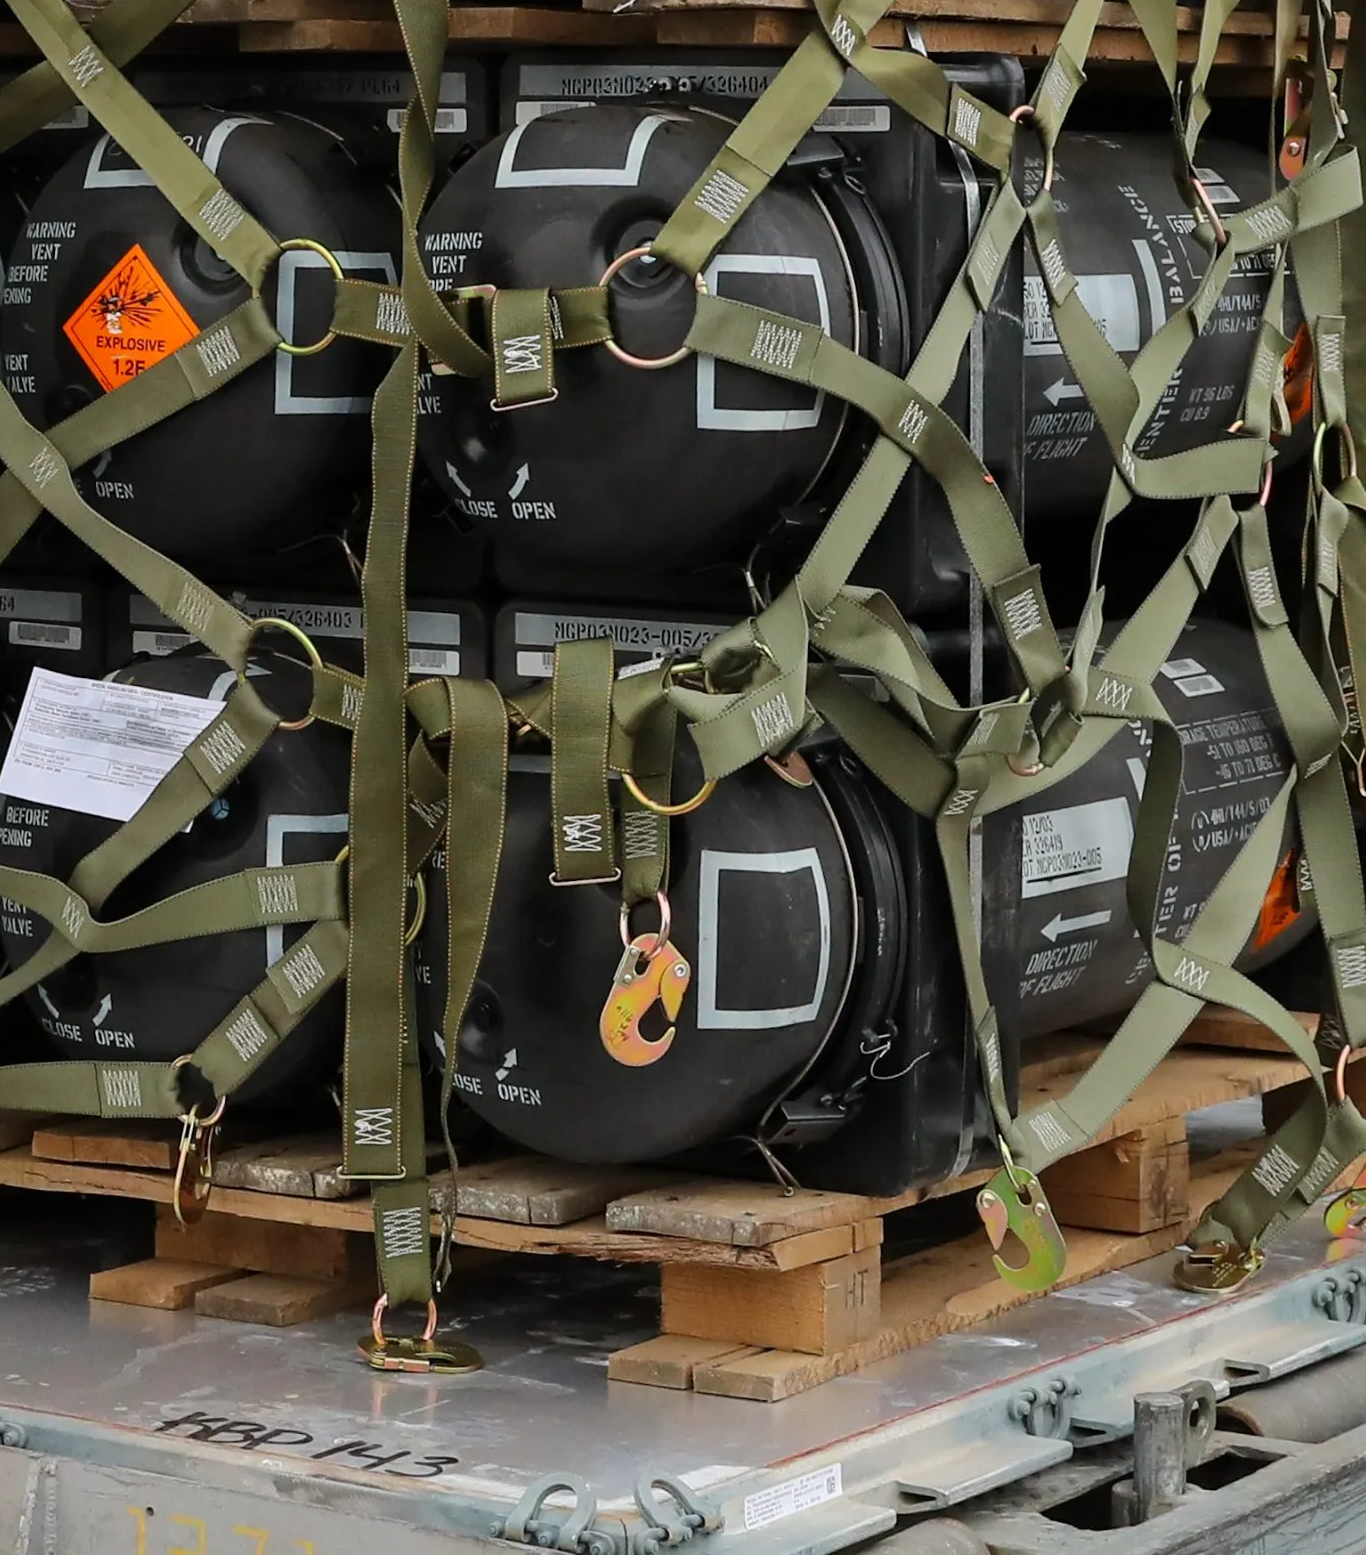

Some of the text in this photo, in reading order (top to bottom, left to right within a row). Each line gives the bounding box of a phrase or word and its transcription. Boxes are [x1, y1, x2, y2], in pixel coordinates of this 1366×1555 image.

[26, 221, 76, 239] WARNING
[425, 231, 483, 251] WARNING
[31, 243, 61, 261] VENT
[1118, 185, 1184, 304] BALANCE
[9, 265, 48, 283] BEFORE
[432, 254, 467, 275] VENT
[4, 288, 32, 305] ENING
[96, 335, 166, 353] EXPLOSIVE
[4, 353, 29, 372] VENT
[1033, 437, 1088, 460] FLIGHT
[95, 480, 134, 499] OPEN
[455, 498, 557, 520] CLOSE OPEN
[6, 805, 49, 827] BEFORE
[2, 914, 34, 937] VALVE
[1025, 939, 1098, 976] DIRECTION
[1035, 966, 1086, 996] FLIGHT
[41, 1018, 135, 1049] CLOSE OPEN
[498, 1083, 542, 1106] OPEN
[154, 1412, 459, 1478] KBP 143
